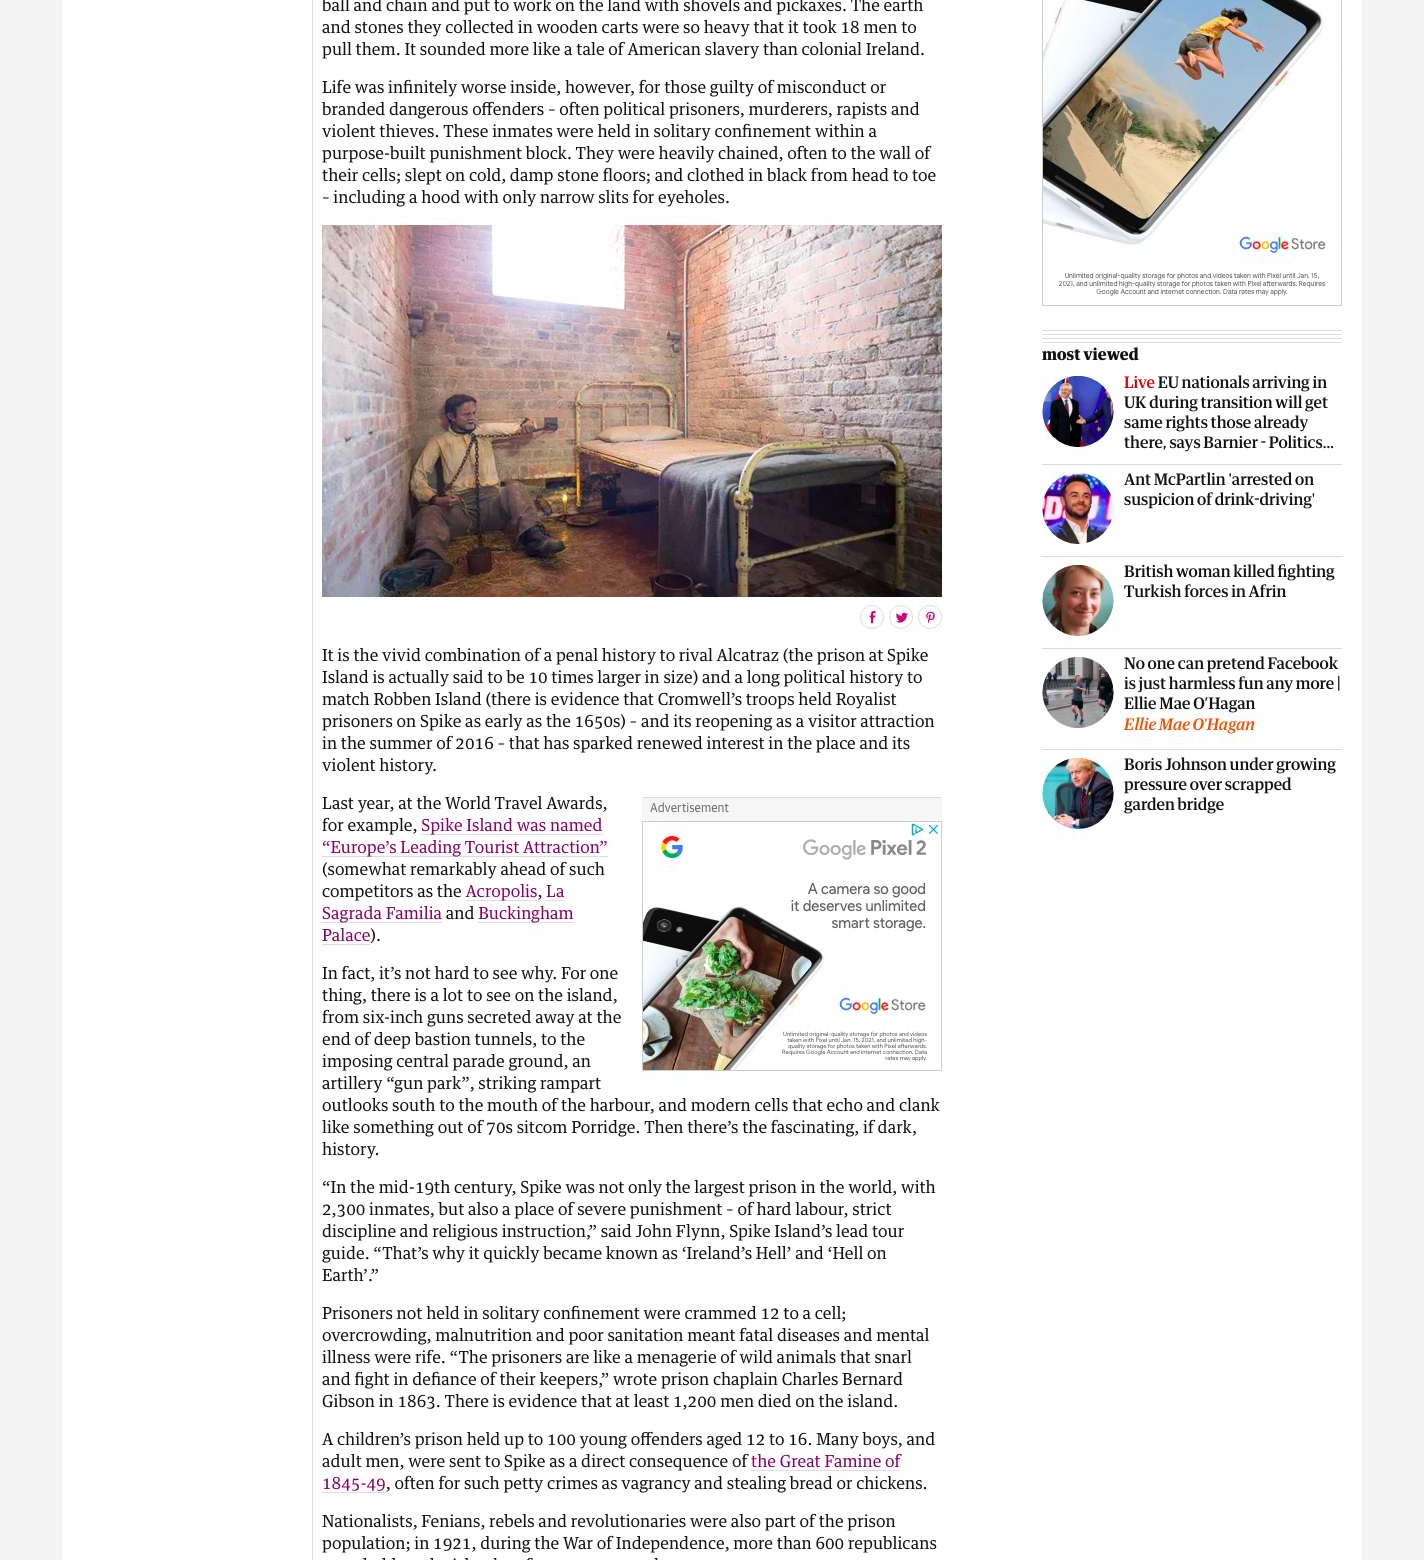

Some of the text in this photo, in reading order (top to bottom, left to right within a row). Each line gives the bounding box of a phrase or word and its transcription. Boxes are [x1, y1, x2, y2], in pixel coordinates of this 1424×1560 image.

[1041, 347, 1139, 361] most viewed
[1123, 375, 1327, 392] Live EU nationals arriving in
